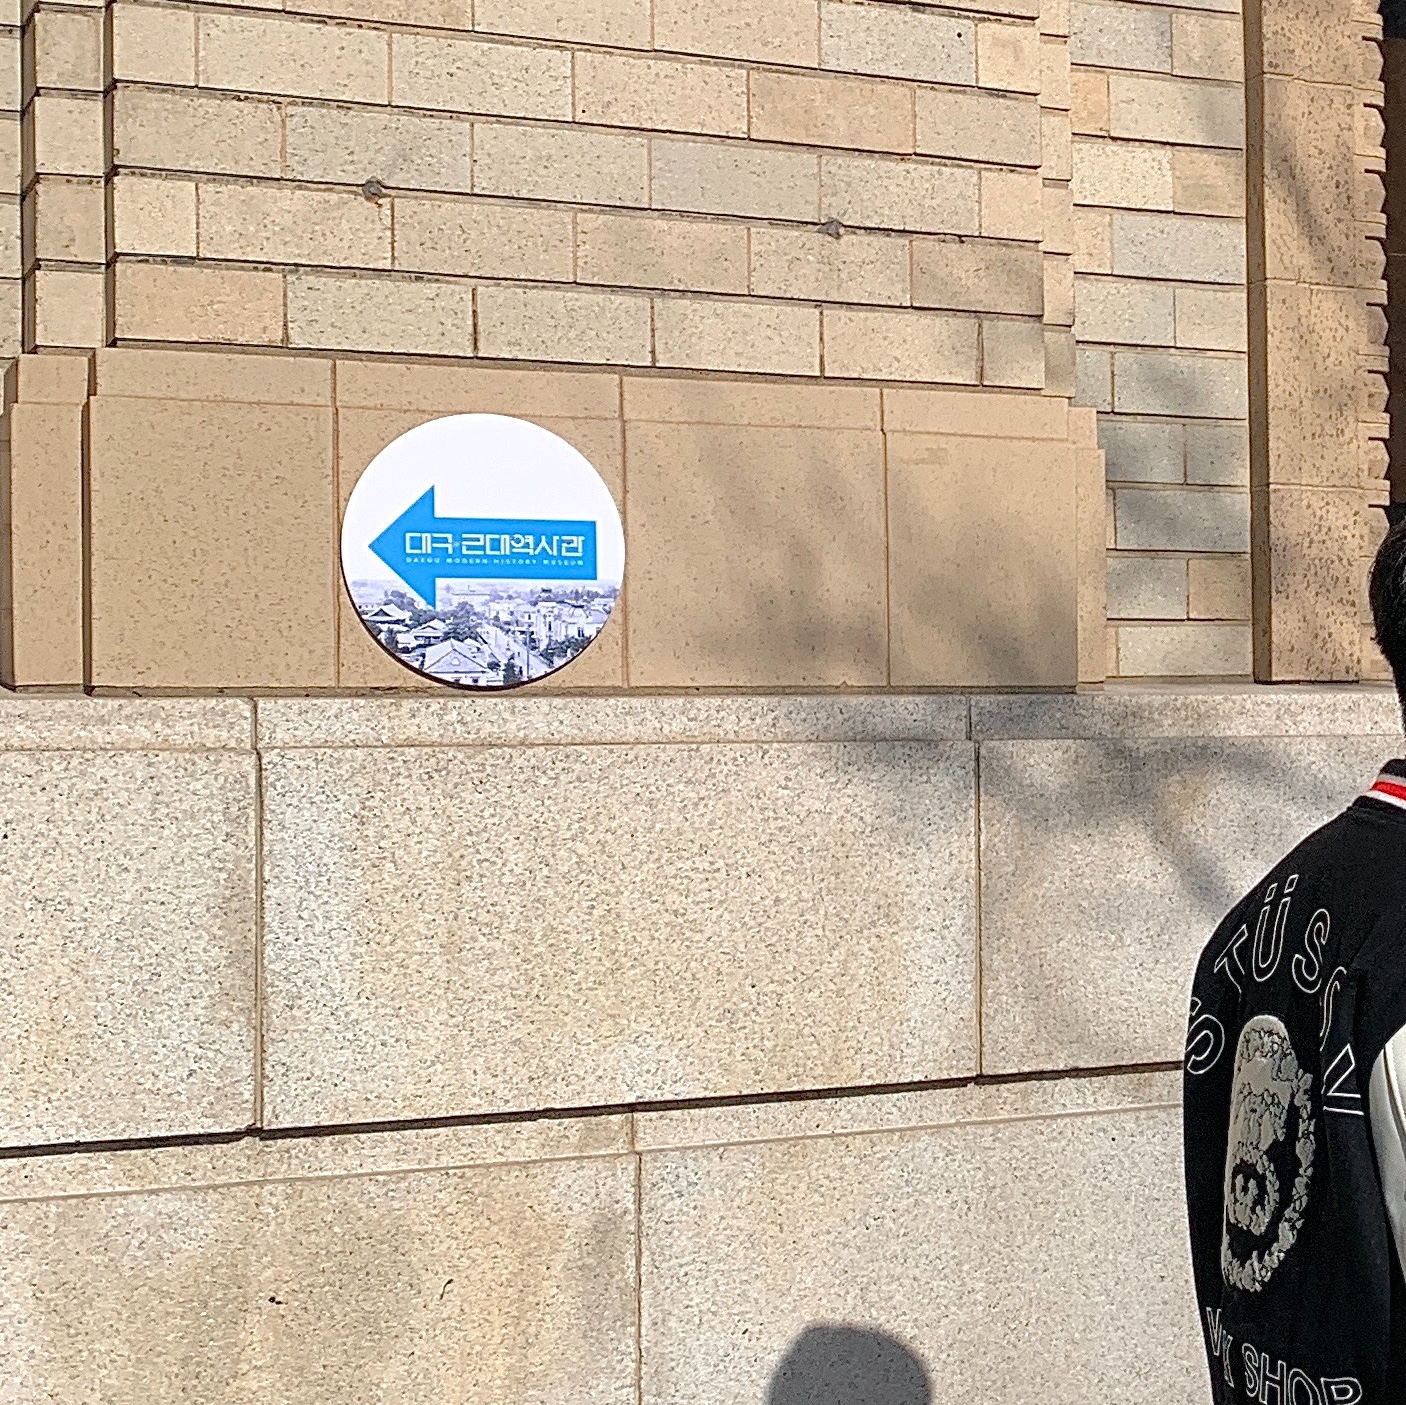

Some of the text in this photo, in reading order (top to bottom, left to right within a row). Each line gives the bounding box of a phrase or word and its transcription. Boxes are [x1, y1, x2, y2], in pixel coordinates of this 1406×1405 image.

[405, 532, 586, 557] 대구 근대역사관
[405, 556, 441, 564] DAEGU
[445, 557, 488, 565] MODERN
[493, 558, 537, 566] HISTORY
